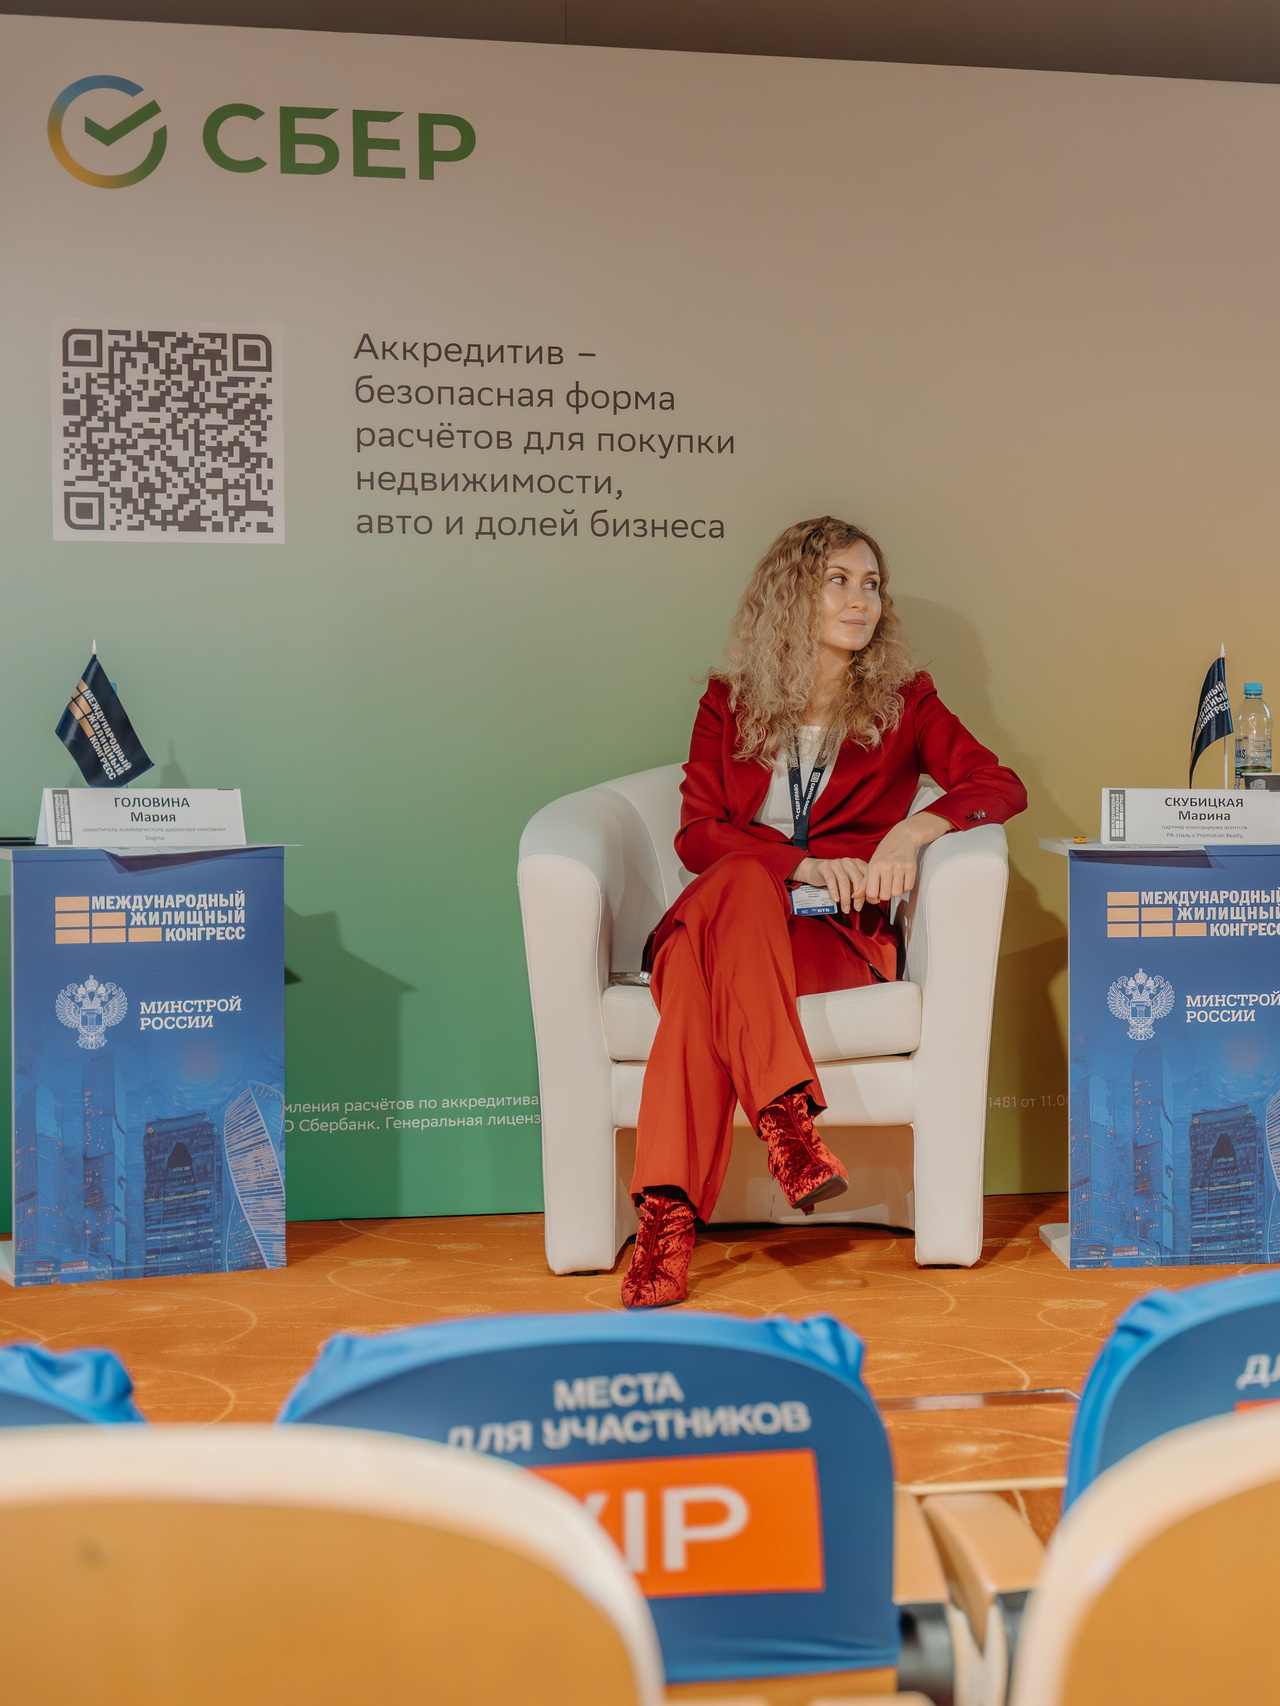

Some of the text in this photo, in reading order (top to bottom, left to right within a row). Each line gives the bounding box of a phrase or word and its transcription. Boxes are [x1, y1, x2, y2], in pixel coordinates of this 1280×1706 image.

[202, 102, 477, 181] СБЕР
[353, 333, 564, 368] Аккредитив
[354, 375, 675, 415] безопасная форма
[356, 422, 735, 459] расчётов для покупки
[356, 470, 623, 500] недвижимости,
[356, 509, 725, 540] авто и долей бизнеса
[82, 689, 132, 771] МЕЖДУНАРОДНЫЙ
[86, 712, 125, 776] ЖИЛИЩНЫЙ
[89, 735, 117, 780] КОНГРЕСС
[114, 797, 190, 808] ГОЛОВИНА
[1164, 797, 1244, 809] СКУБИЦКАЯ
[130, 811, 176, 823] Мария
[1178, 810, 1231, 821] Марина
[91, 889, 245, 911] МЕЖДУНАРОДНЫЙ
[130, 906, 245, 926] ЖИЛИЩНЫЙ
[165, 926, 246, 942] КОНГРЕСС
[139, 995, 242, 1015] МИНСТРОЙ
[1185, 1009, 1256, 1023] РОССИИ
[139, 1015, 214, 1031] РОССИИ
[284, 1094, 539, 1114] мления расчётов по аккредитива
[987, 1094, 1067, 1108] 1481 от 11.0
[299, 1117, 380, 1134] Сбербанк.
[385, 1114, 483, 1130] Генеральная
[487, 1112, 541, 1127] лиценз
[553, 1371, 684, 1411] МЕСТА
[541, 1401, 811, 1450] УЧАСТНИКОВ
